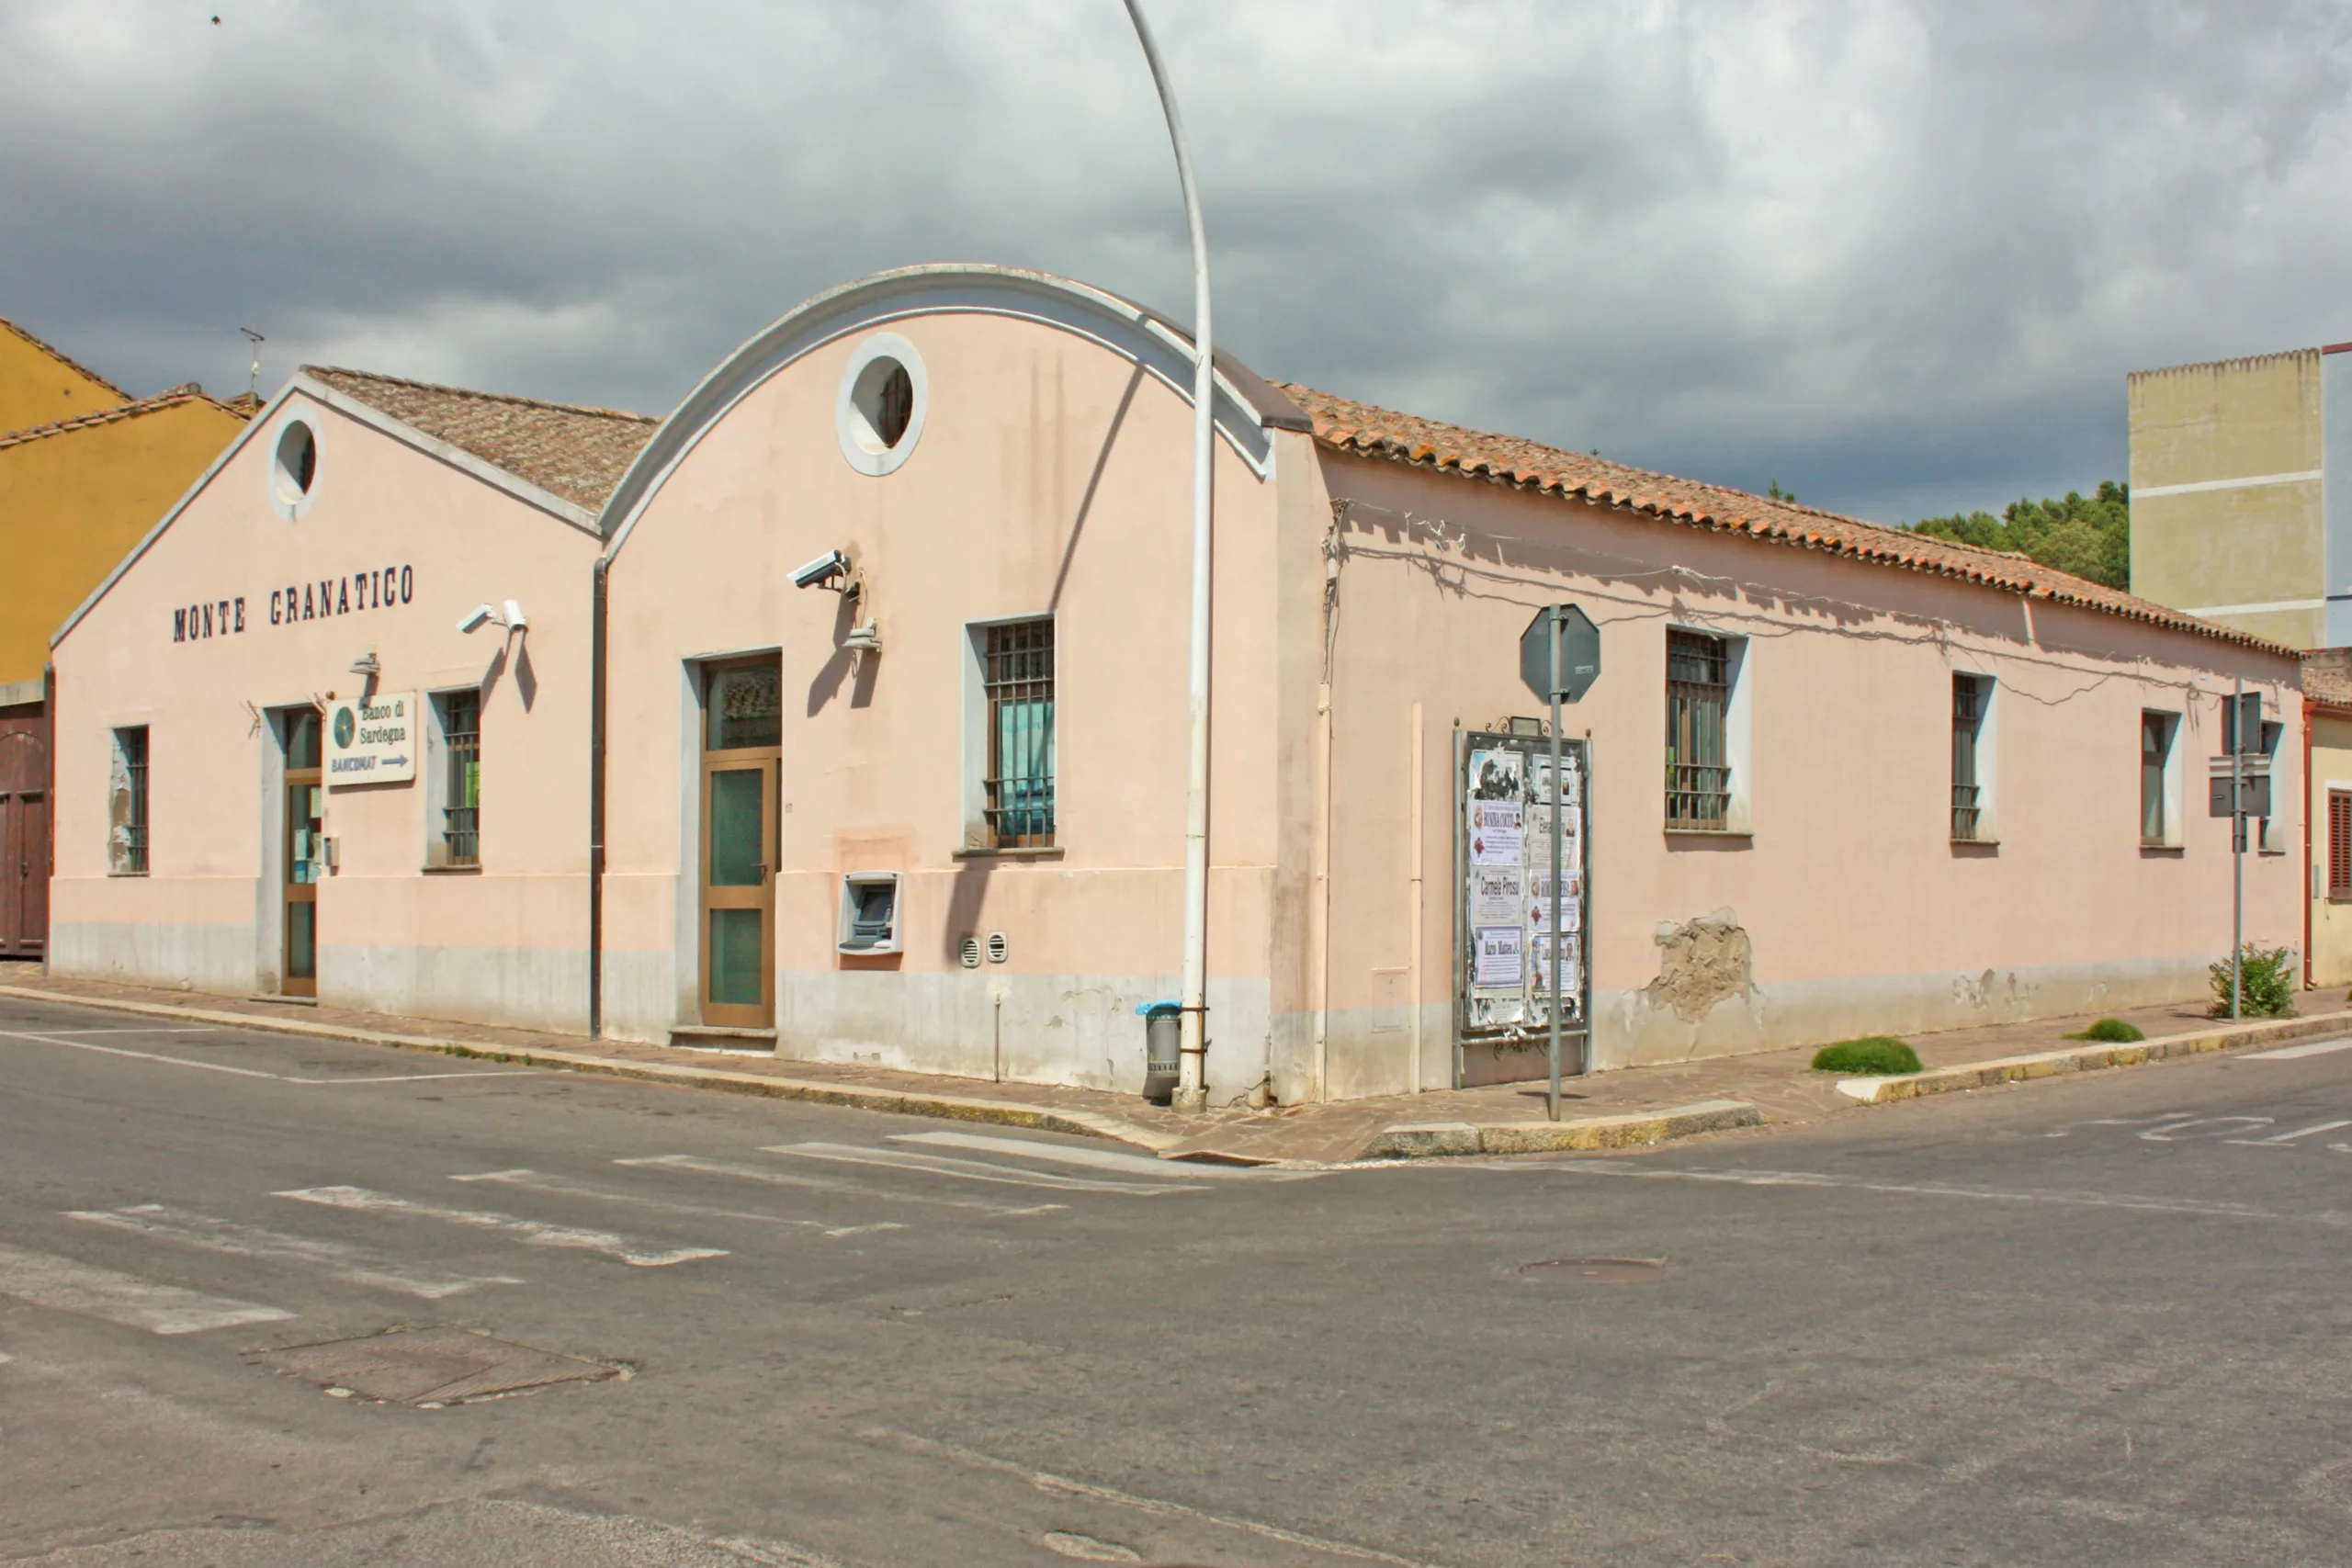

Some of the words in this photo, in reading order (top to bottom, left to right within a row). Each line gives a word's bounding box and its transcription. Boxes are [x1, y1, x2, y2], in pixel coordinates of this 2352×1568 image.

[173, 597, 245, 643] MONTE
[270, 564, 413, 626] GRANATICO
[362, 704, 391, 720] Banco
[395, 700, 404, 717] di
[359, 726, 406, 745] Sardegna
[332, 755, 377, 773] BANCOMAT
